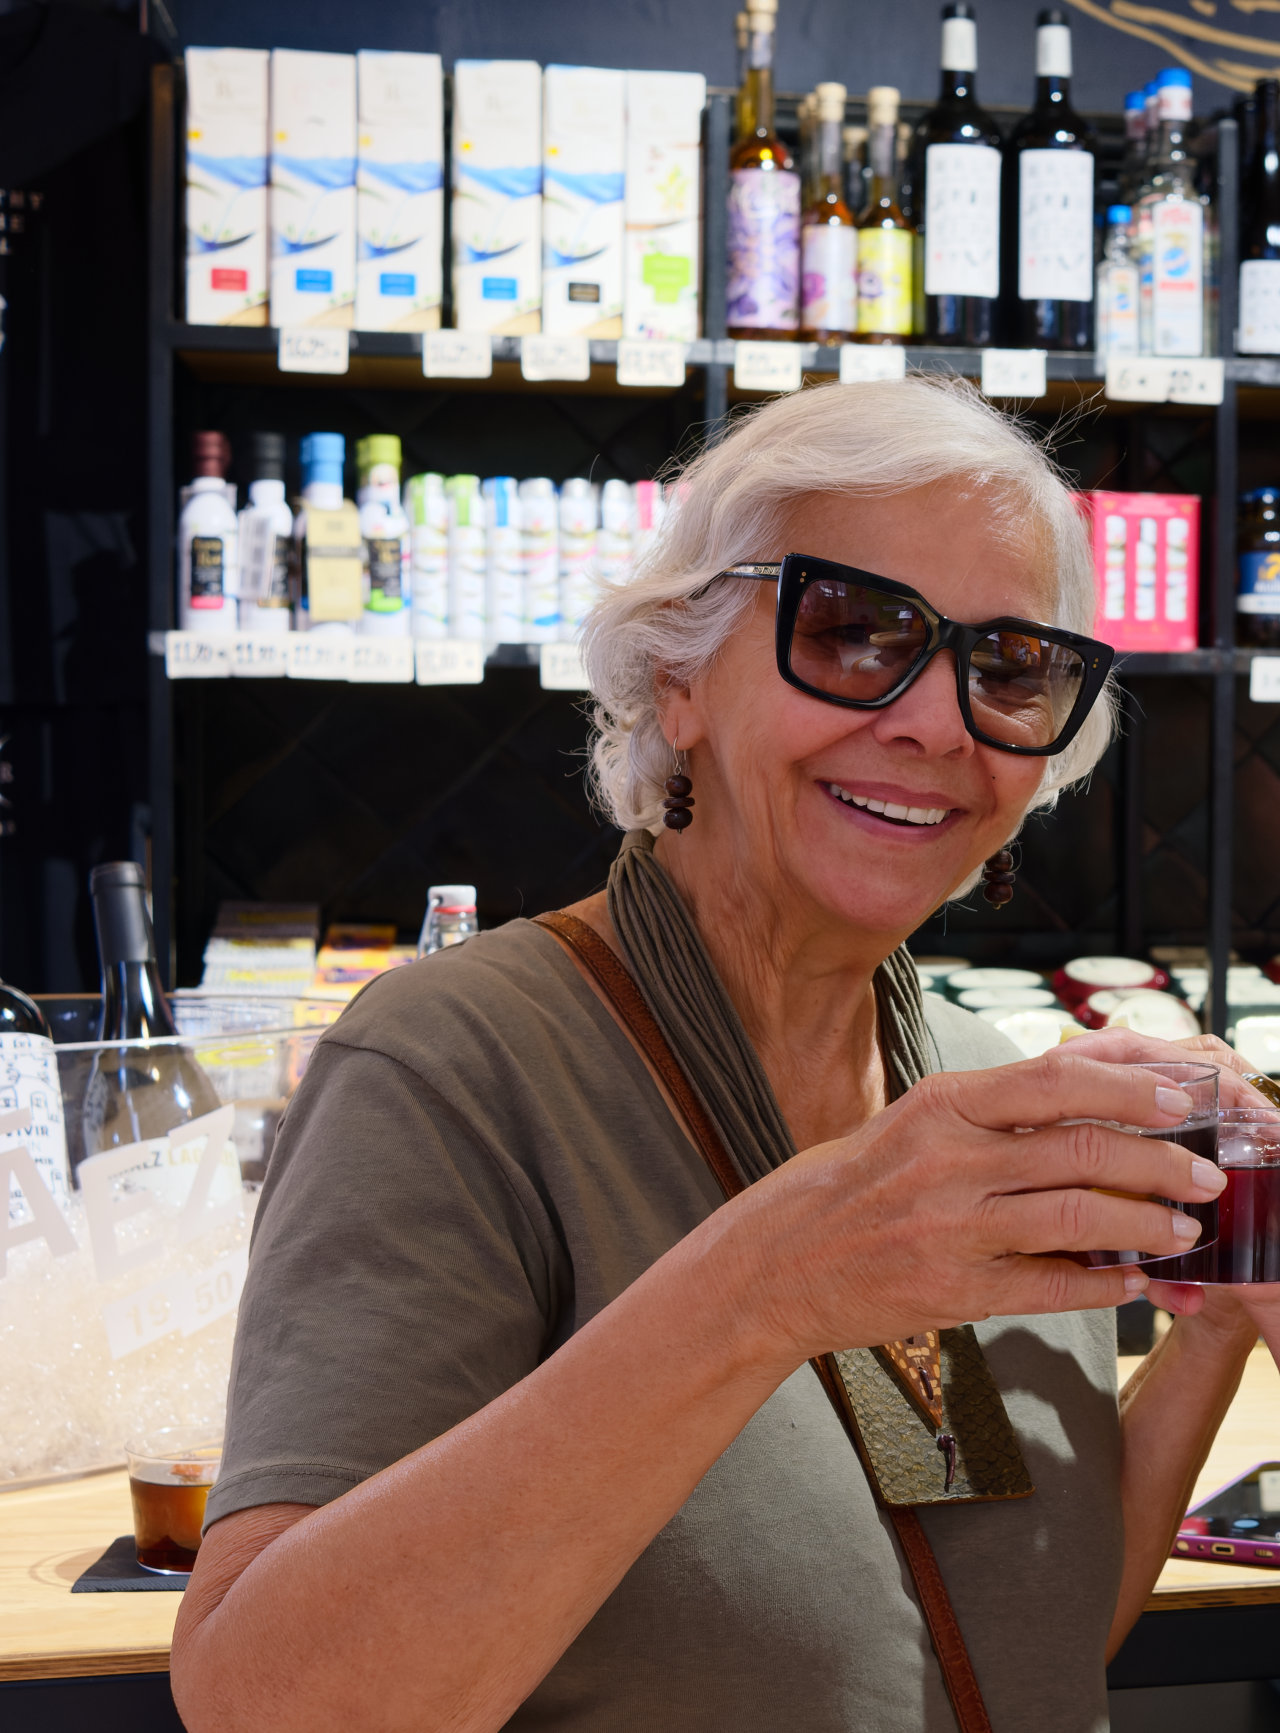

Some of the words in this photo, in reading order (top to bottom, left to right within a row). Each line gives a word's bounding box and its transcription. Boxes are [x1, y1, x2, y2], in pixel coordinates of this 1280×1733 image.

[6, 1124, 49, 1137] IVIR
[125, 1291, 172, 1337] 19
[194, 1271, 234, 1317] 50
